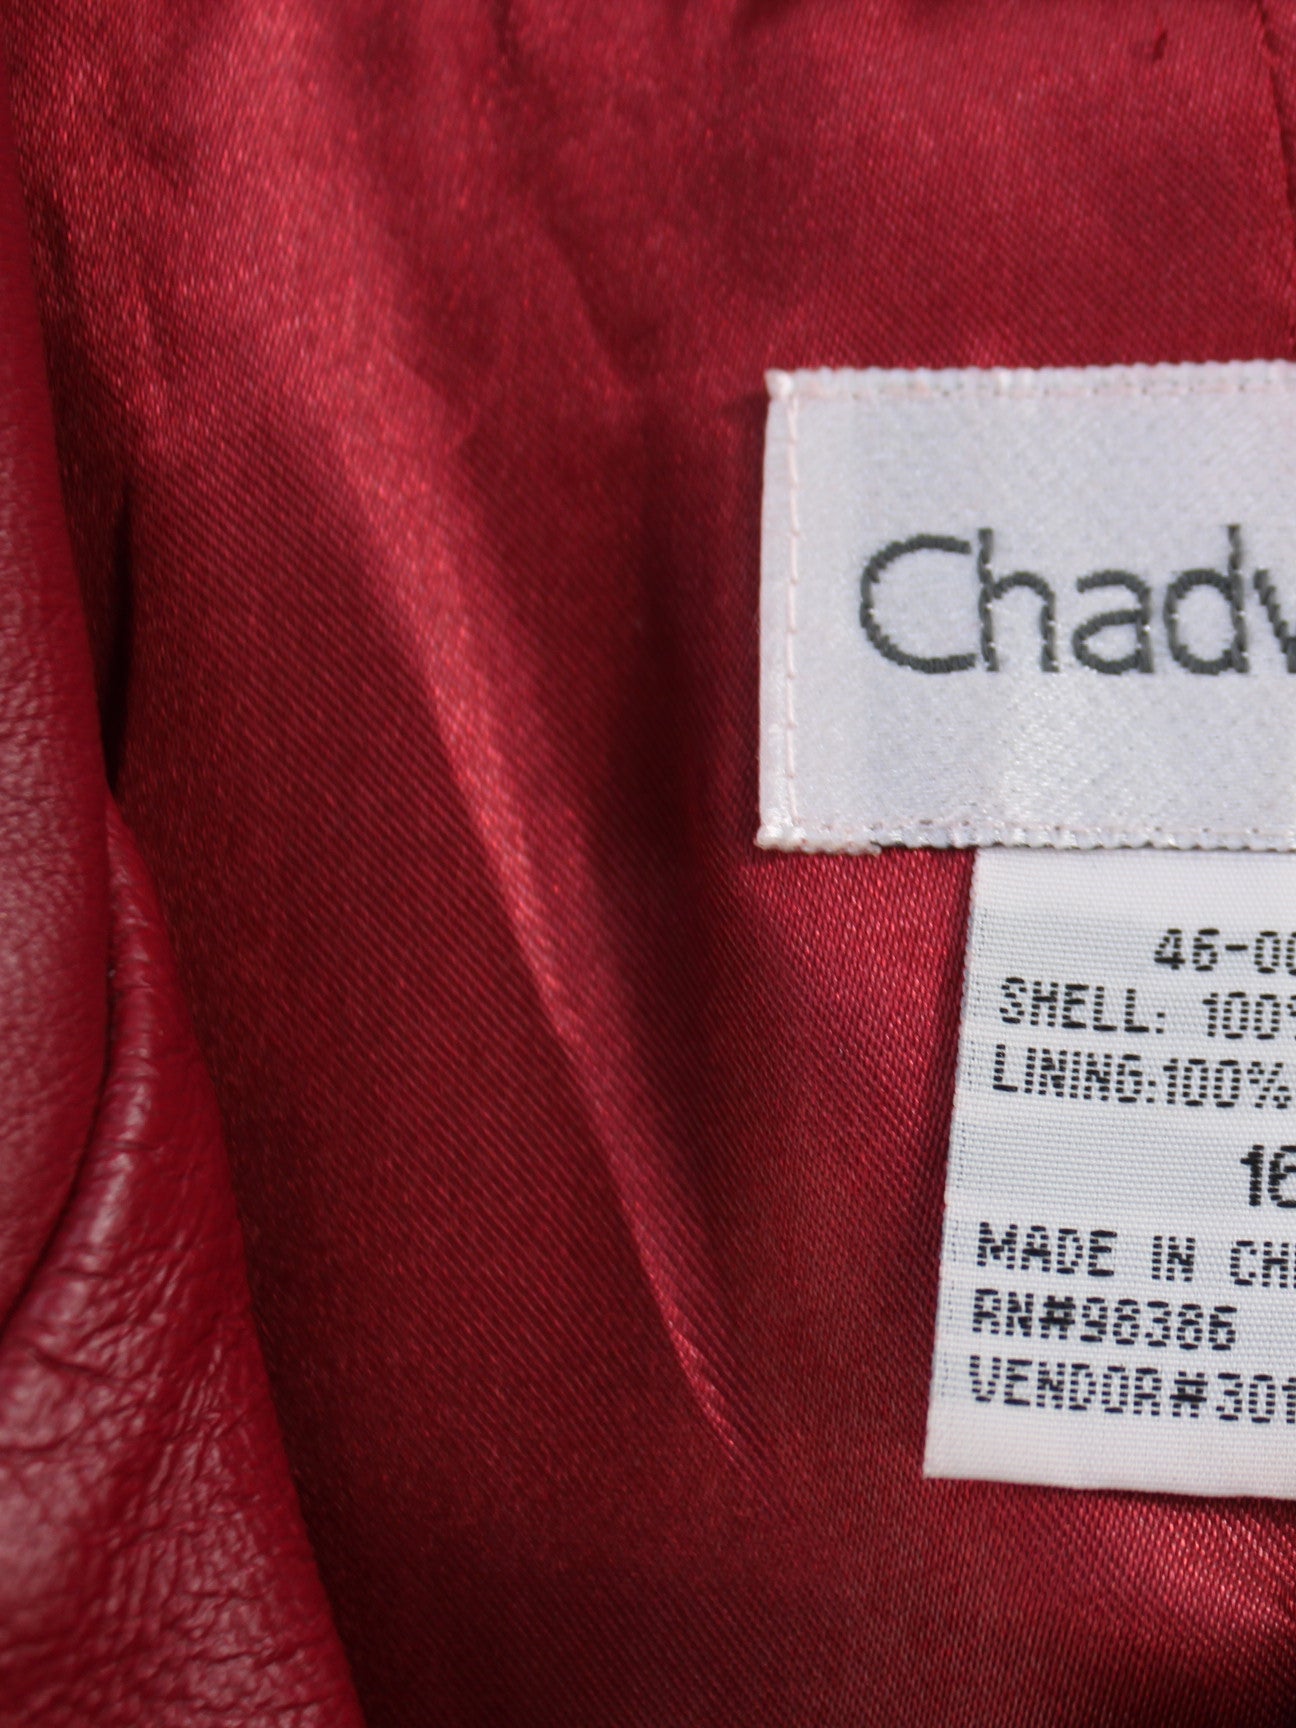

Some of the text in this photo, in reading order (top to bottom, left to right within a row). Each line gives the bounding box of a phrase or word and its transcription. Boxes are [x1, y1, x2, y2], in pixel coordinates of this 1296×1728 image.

[998, 977, 1167, 1034] SHELL:
[976, 1221, 1118, 1278] MADE
[1151, 1235, 1197, 1283] IN
[971, 1288, 1239, 1352] RN#98386
